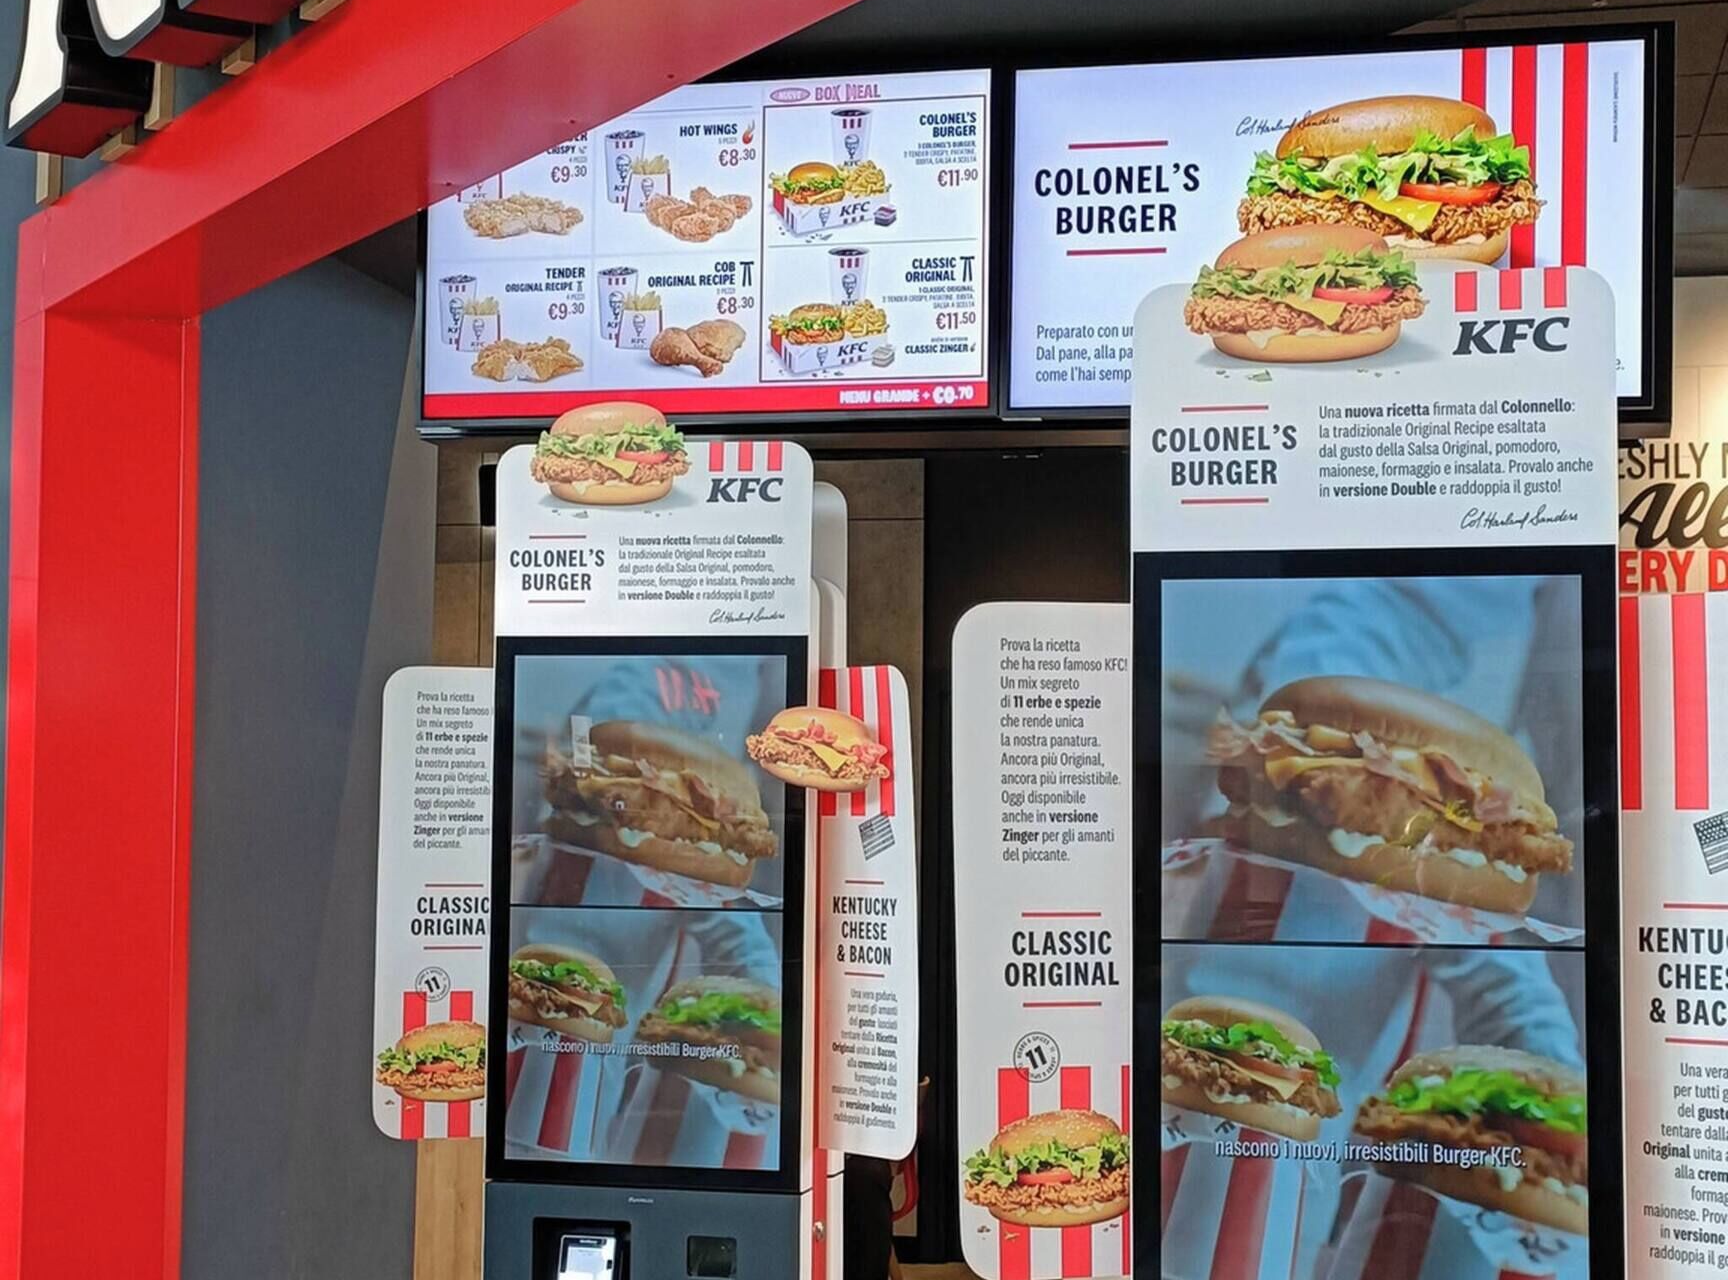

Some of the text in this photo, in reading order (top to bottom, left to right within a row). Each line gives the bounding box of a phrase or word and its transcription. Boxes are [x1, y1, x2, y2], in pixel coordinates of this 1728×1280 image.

[815, 86, 840, 102] BOX
[846, 84, 881, 101] MEAL
[920, 112, 977, 126] COLONEL'S
[680, 124, 738, 138] HOT WINGS
[933, 126, 976, 139] BURGER
[1035, 163, 1201, 197] COLONEL'S
[839, 202, 870, 218] KFC
[1056, 203, 1178, 236] BURGER
[714, 262, 736, 273] COB
[912, 258, 957, 269] CLASSIC
[546, 268, 585, 280] TENDER
[648, 274, 736, 288] ORIGINAL RECIPE
[905, 271, 956, 282] ORIGINAL
[505, 281, 573, 293] ORIGINAL RECIPE
[1036, 324, 1118, 341] Preparato con
[1453, 316, 1570, 357] KFC
[838, 341, 868, 358] KFC
[905, 343, 968, 354] CLASSIC ZINGER
[1036, 344, 1115, 362] Dal pane, alla
[1035, 366, 1095, 382] come l'hai
[873, 389, 920, 403] GRANDE
[1319, 398, 1574, 419] Una nuova ricetta firmata dal Colonnello:
[1319, 419, 1545, 438] la tradizionale Original Recipe esaltata
[1152, 424, 1298, 455] COLONEL'S
[1318, 438, 1560, 460] dal gusto della Salsa Original, pomodoro,
[1171, 458, 1278, 487] BURGER
[1319, 457, 1593, 478] maionese, formaggio e insalata. Provalo anche
[706, 477, 784, 503] KFC
[1319, 478, 1560, 497] in versione Double e raddoppia il gusto!
[510, 549, 605, 568] COLONEL'S
[521, 573, 592, 591] BURGER
[1000, 637, 1080, 652] Prova la ricetta
[1000, 656, 1127, 671] che ha reso famoso KFC!
[1000, 676, 1079, 692] Un mix segreto
[1000, 694, 1100, 711] di 11 erbe e spezie
[1000, 713, 1084, 727] che rende unica
[1000, 732, 1100, 749] la nostra panatura.
[1000, 752, 1104, 768] Ancora più Original,
[1000, 771, 1120, 787] ancora più irresistibile.
[1001, 790, 1086, 806] Oggi disponibile
[1002, 809, 1098, 822] anche in versione
[1002, 828, 1114, 844] Zinger per gli amanti
[1002, 847, 1070, 864] del piccante.
[417, 896, 490, 915] CLASSIC
[832, 896, 897, 916] KENTUCKY
[841, 921, 887, 941] CHEESE
[1012, 930, 1112, 956] CLASSIC
[1639, 927, 1728, 954] KENTU
[837, 944, 892, 965] & BACON
[1004, 961, 1120, 987] ORIGINAL
[1658, 963, 1728, 991] CHEE
[424, 976, 442, 993] 11
[1649, 997, 1666, 1023] &
[1025, 1045, 1047, 1070] 11
[1680, 1062, 1702, 1077] Una
[1673, 1085, 1720, 1099] per tutti
[1677, 1103, 1695, 1118] del
[1661, 1124, 1702, 1139] tentare
[1215, 1140, 1527, 1169] nascono i nuovi, irresistibili Burger KFC.
[1643, 1141, 1722, 1162] Original unita
[1675, 1165, 1695, 1179] alla
[1643, 1204, 1699, 1222] maionese.
[1660, 1224, 1726, 1245] in versione
[1649, 1246, 1715, 1265] raddoppia il
